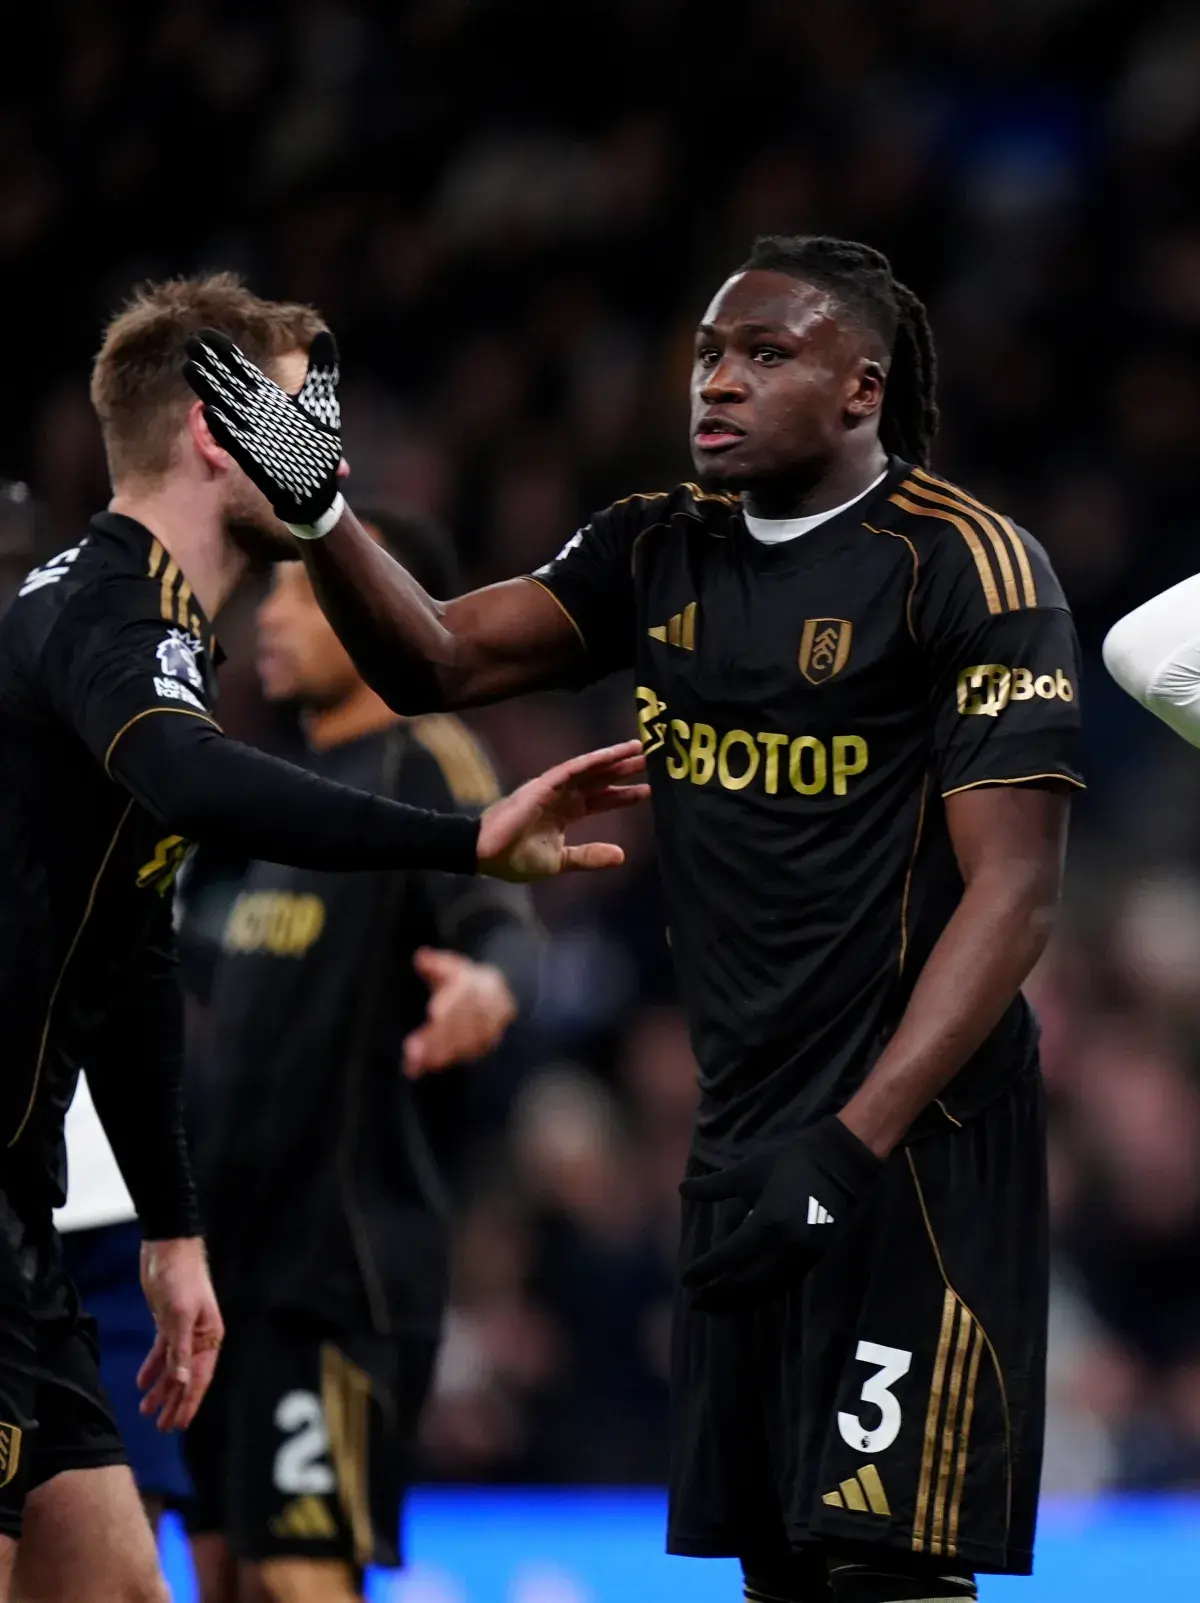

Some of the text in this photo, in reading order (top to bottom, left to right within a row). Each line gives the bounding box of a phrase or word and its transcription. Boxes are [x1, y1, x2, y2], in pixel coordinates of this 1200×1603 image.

[666, 719, 869, 796] SBOTOP
[273, 1390, 334, 1494] 2
[838, 1340, 912, 1453] 3
